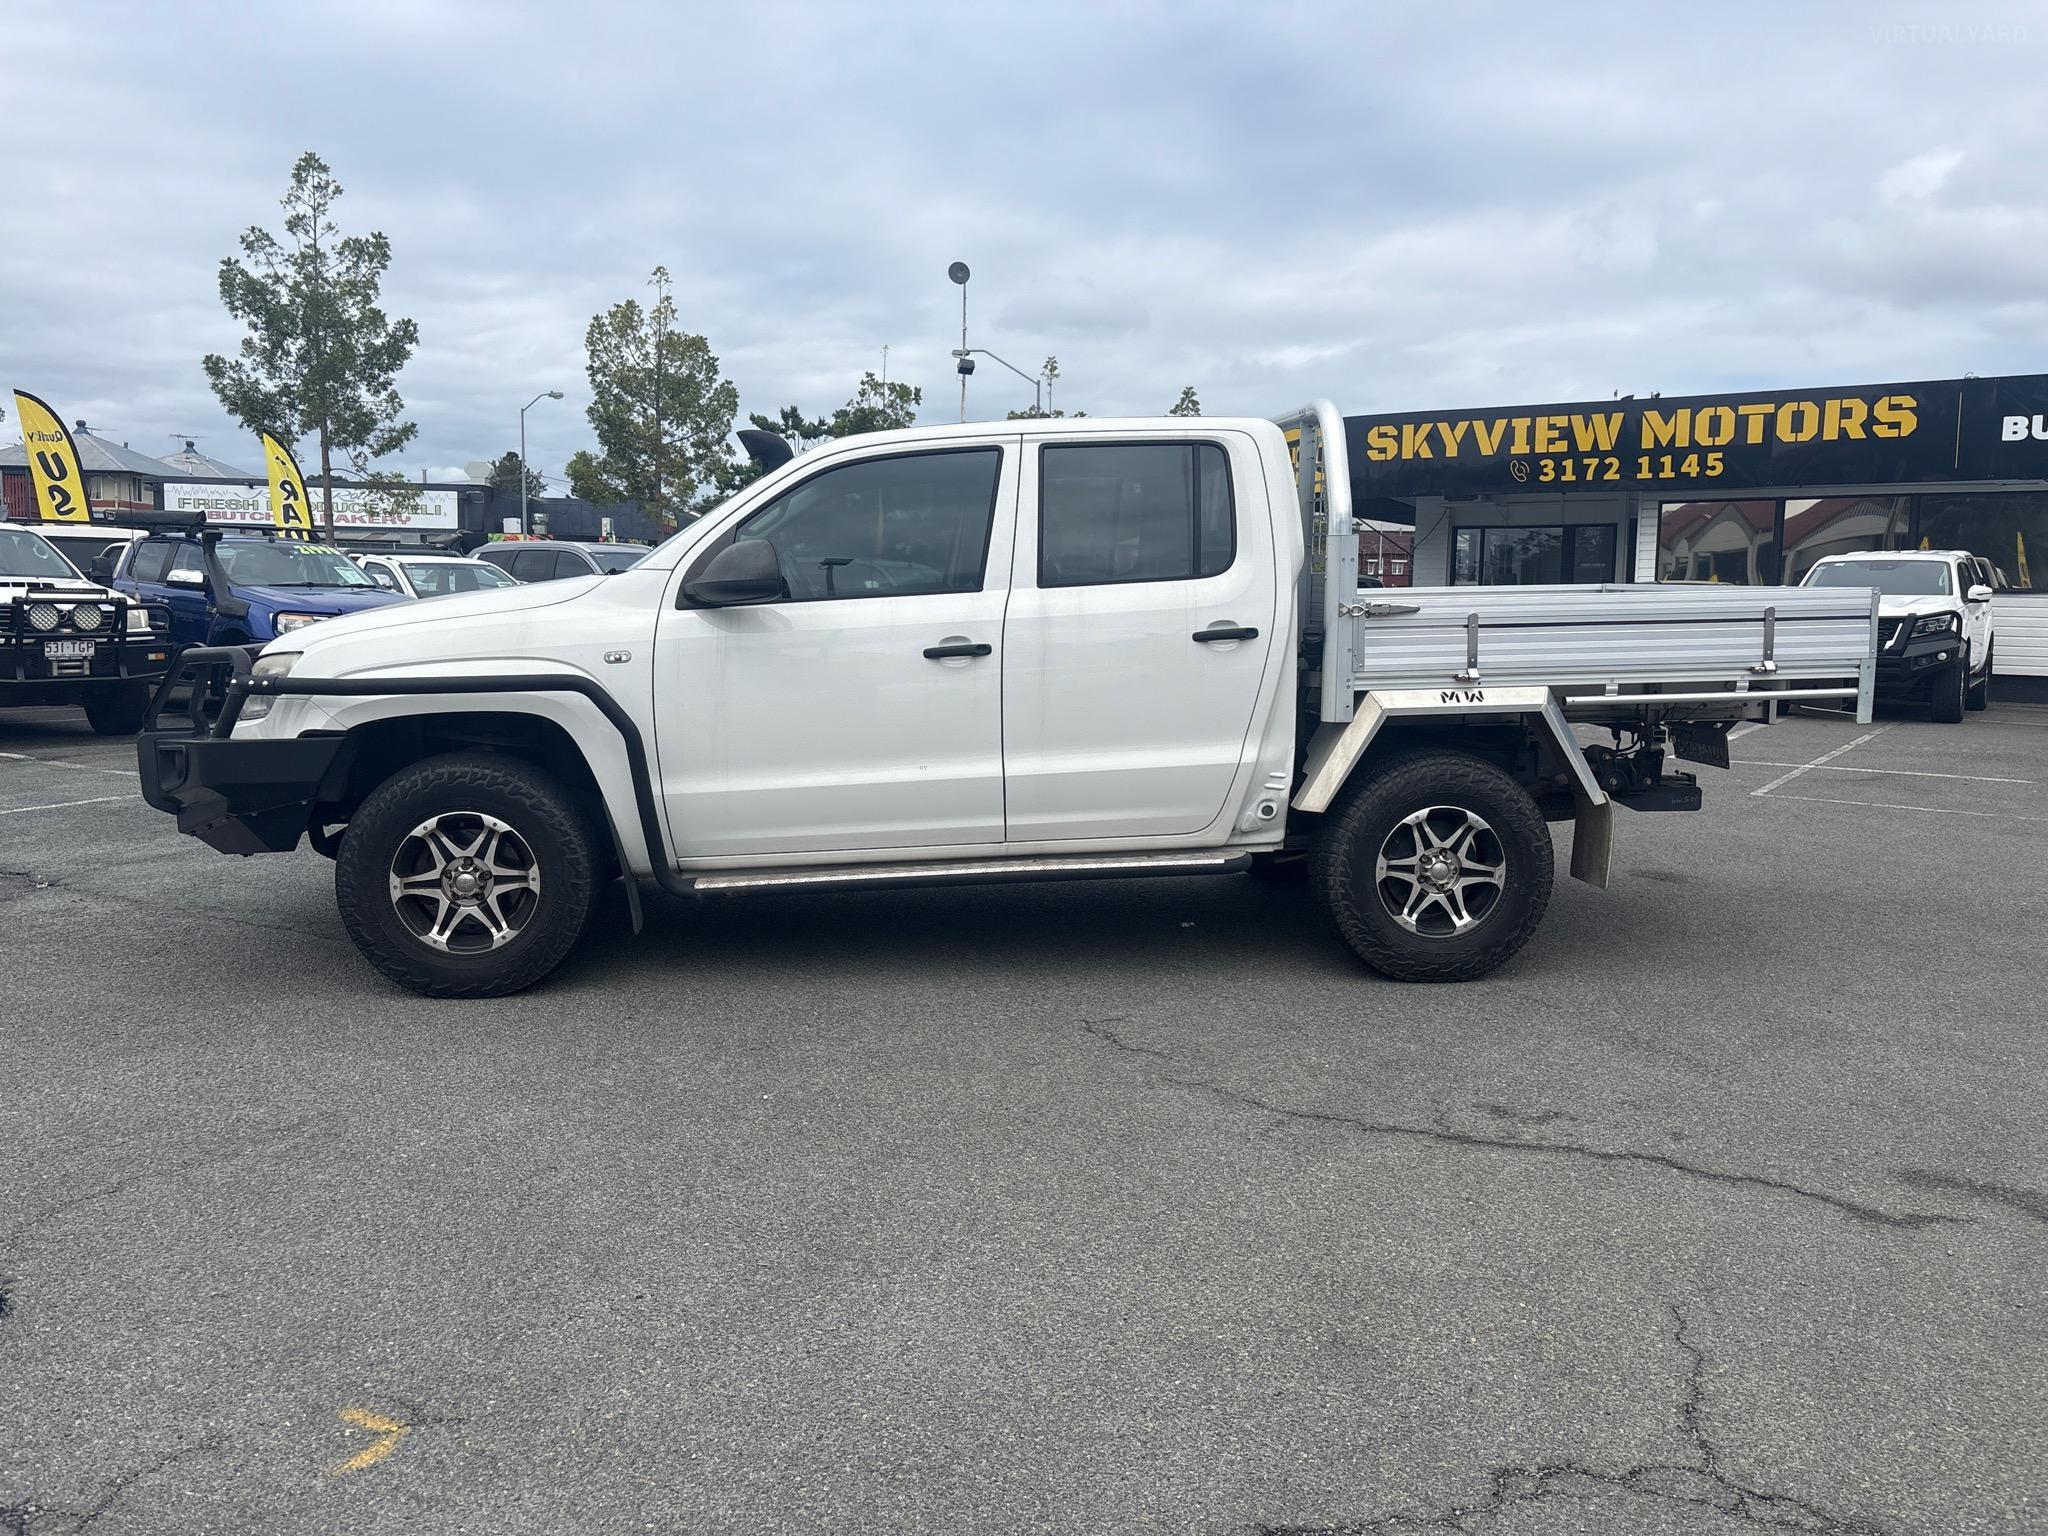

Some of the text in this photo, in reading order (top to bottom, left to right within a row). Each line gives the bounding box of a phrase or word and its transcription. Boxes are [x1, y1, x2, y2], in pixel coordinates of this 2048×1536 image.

[1366, 412, 1625, 461] SKYVIEW
[1641, 395, 1918, 450] MOTORS
[2001, 414, 2048, 441] BU
[1538, 452, 1724, 482] 3172 1145
[178, 497, 260, 511] FRESH
[207, 510, 276, 521] BUTCH
